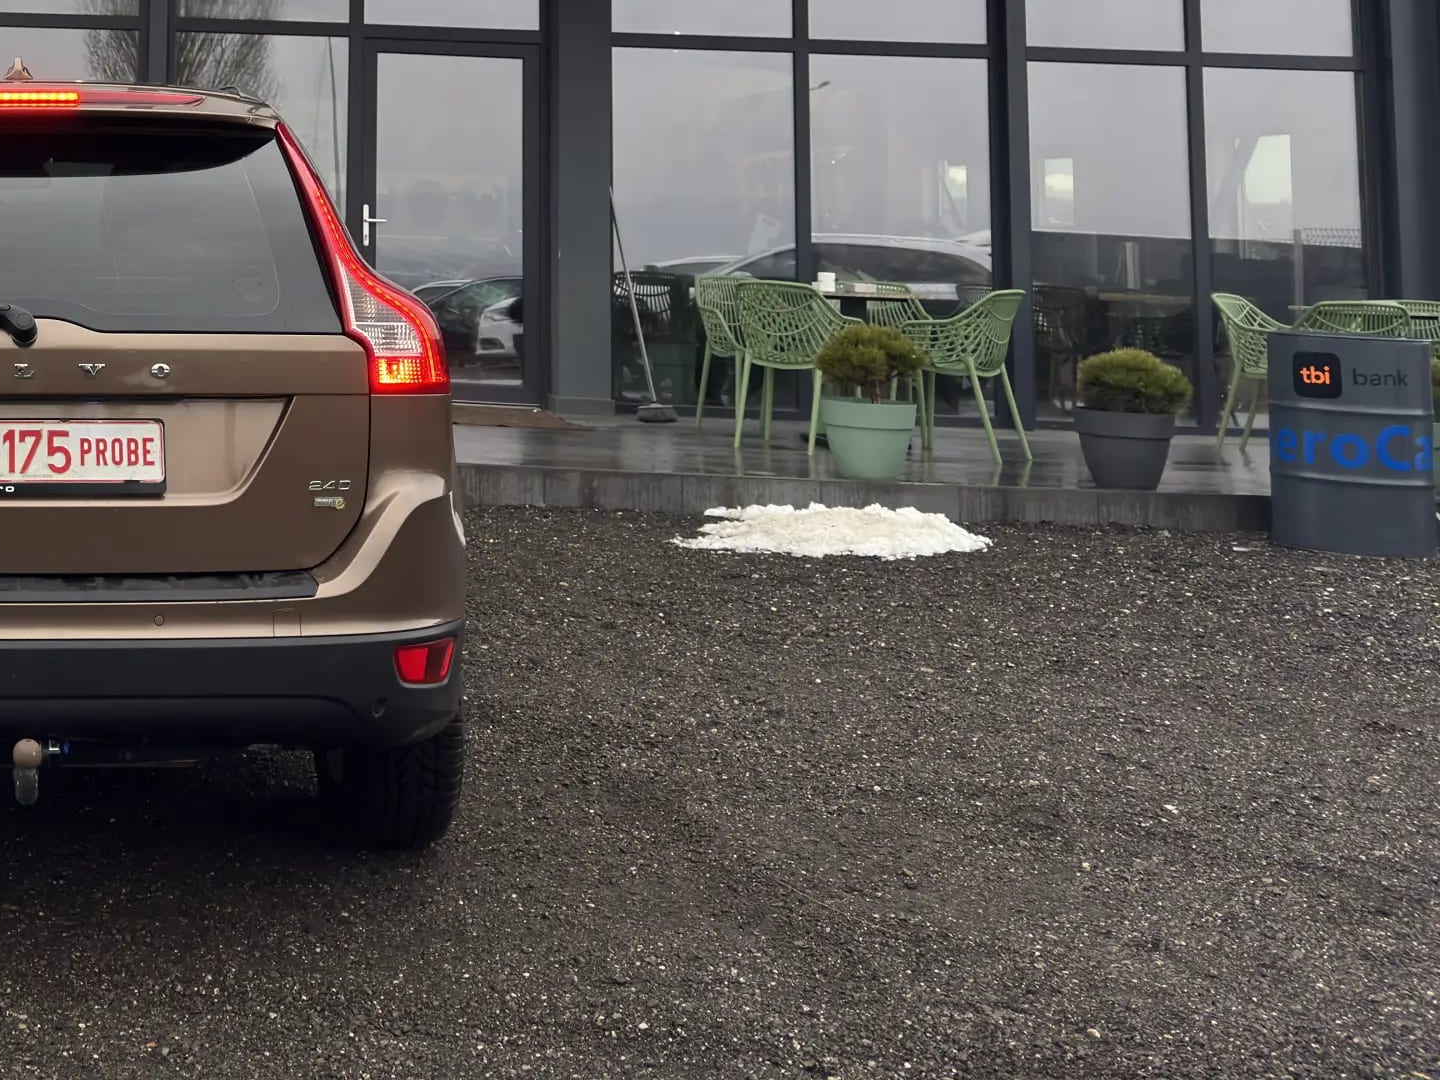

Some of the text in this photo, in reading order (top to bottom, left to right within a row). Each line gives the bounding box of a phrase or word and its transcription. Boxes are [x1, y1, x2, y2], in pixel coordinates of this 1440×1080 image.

[1300, 366, 1409, 387] tbi bank
[2, 429, 72, 474] 175
[79, 437, 155, 466] PROBE
